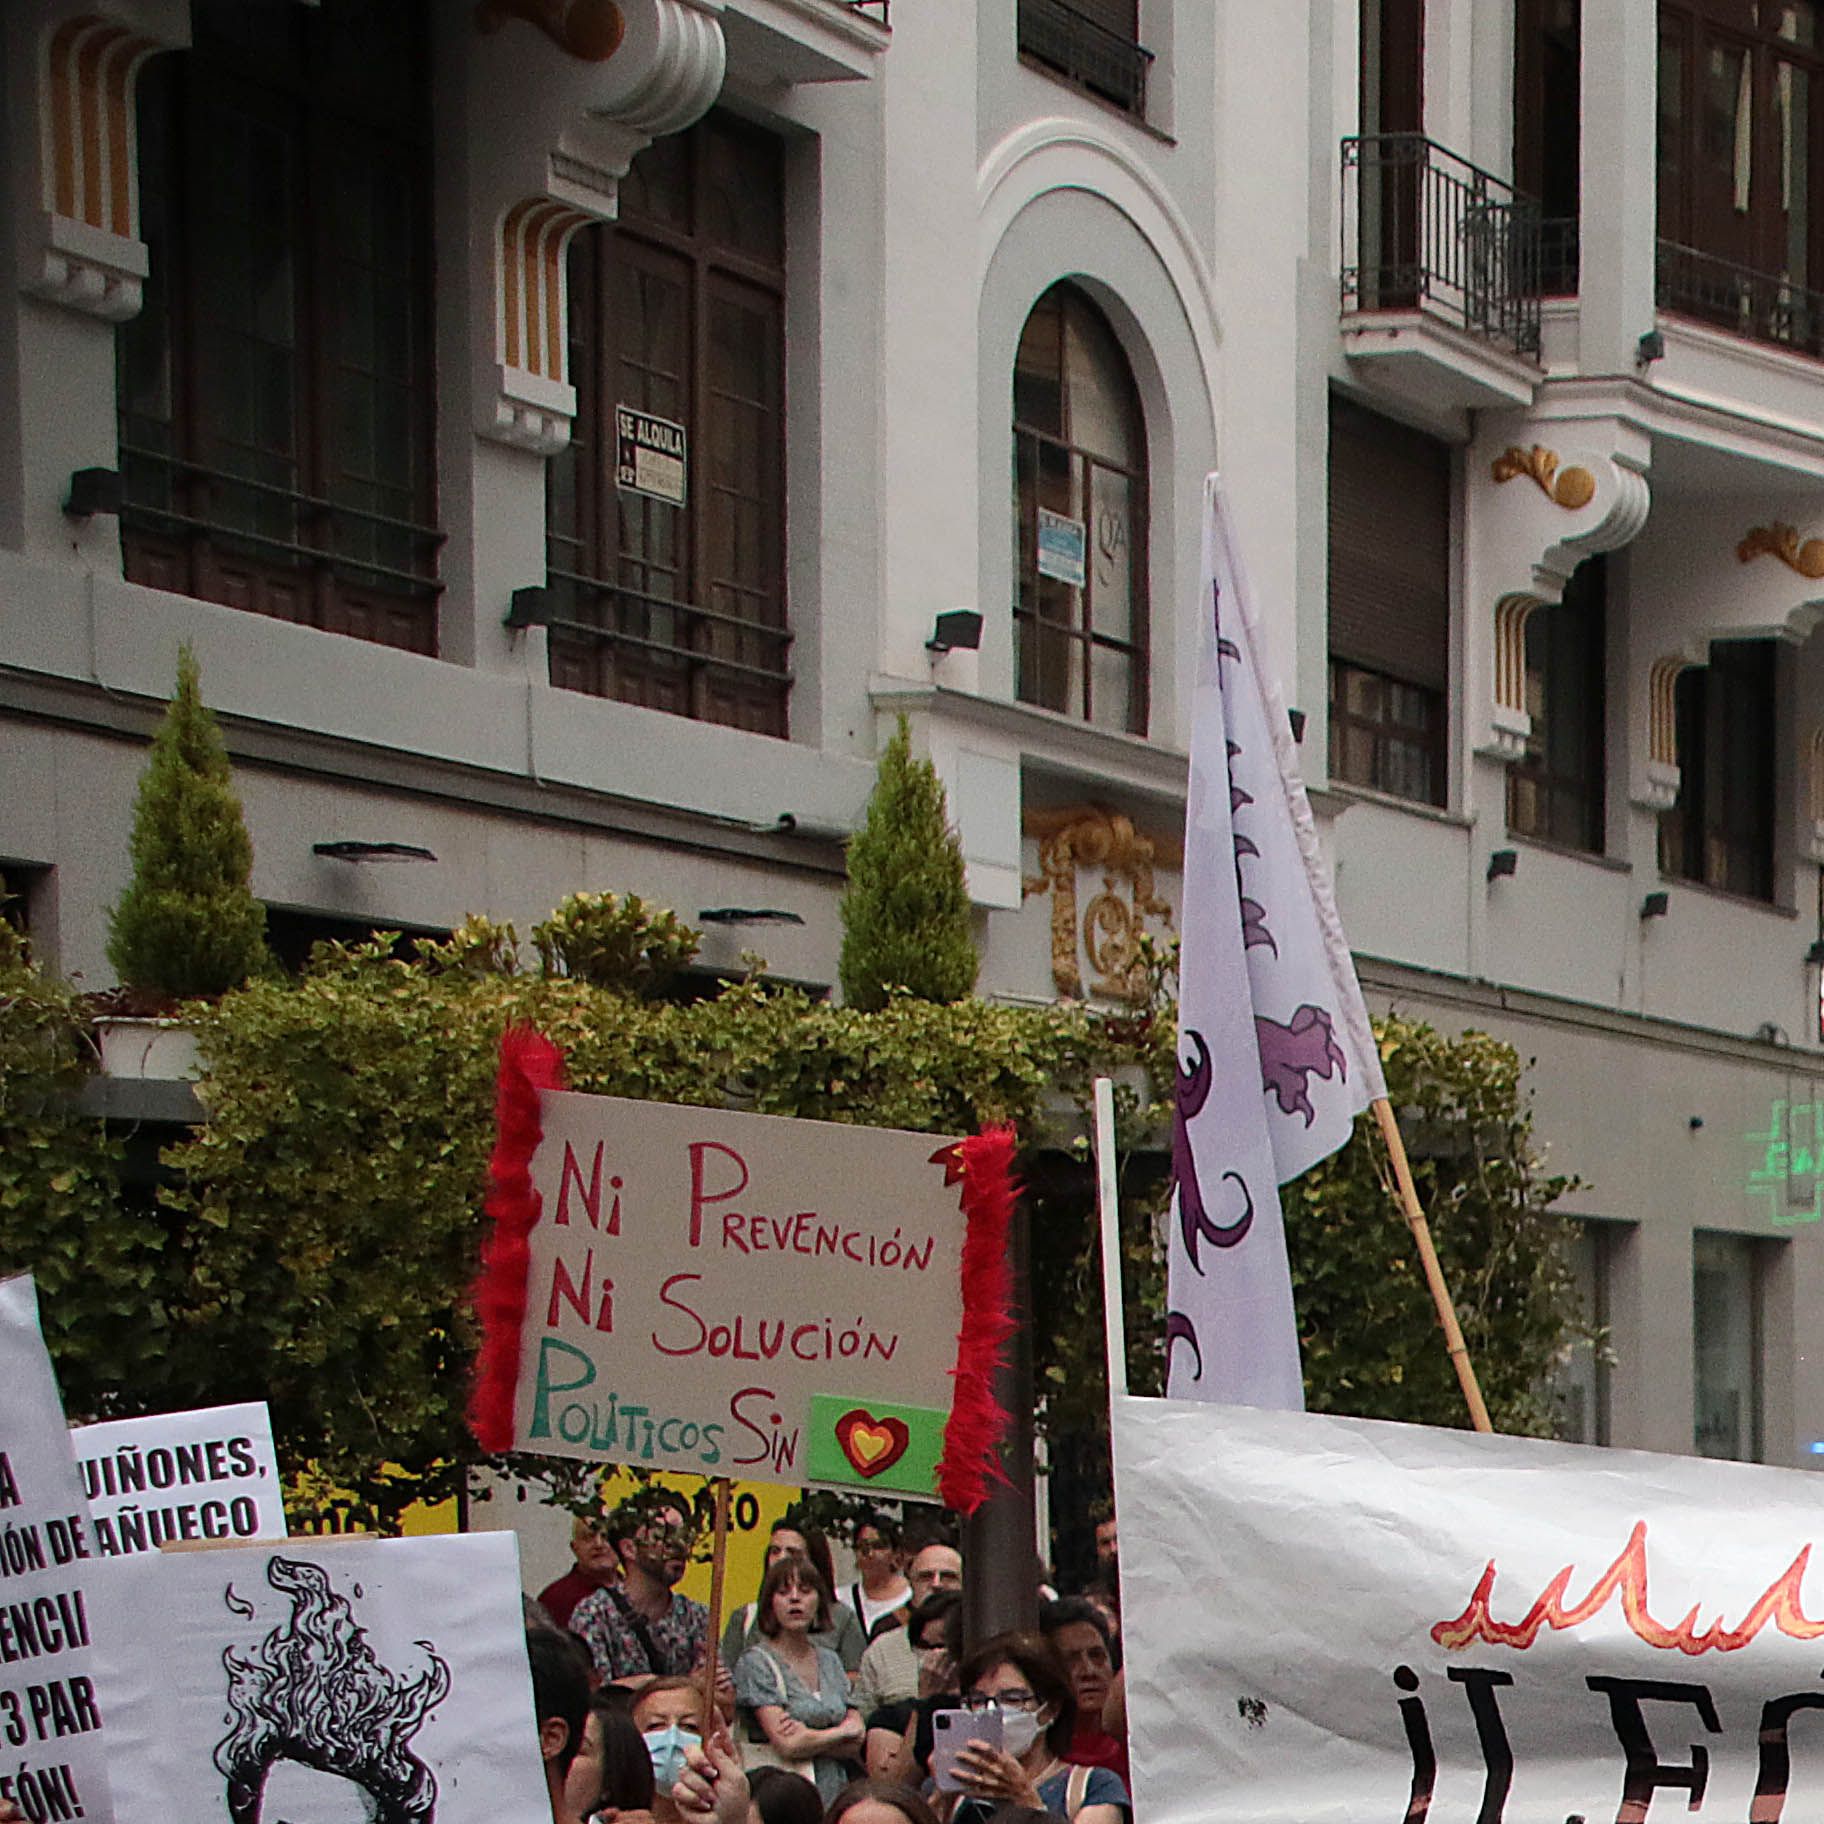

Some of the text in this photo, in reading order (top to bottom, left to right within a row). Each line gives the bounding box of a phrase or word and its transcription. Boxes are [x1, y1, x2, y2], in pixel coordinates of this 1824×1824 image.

[620, 414, 683, 455] SE ALQUILA
[46, 1514, 91, 1566] DE
[27, 1675, 103, 1742] PAR
